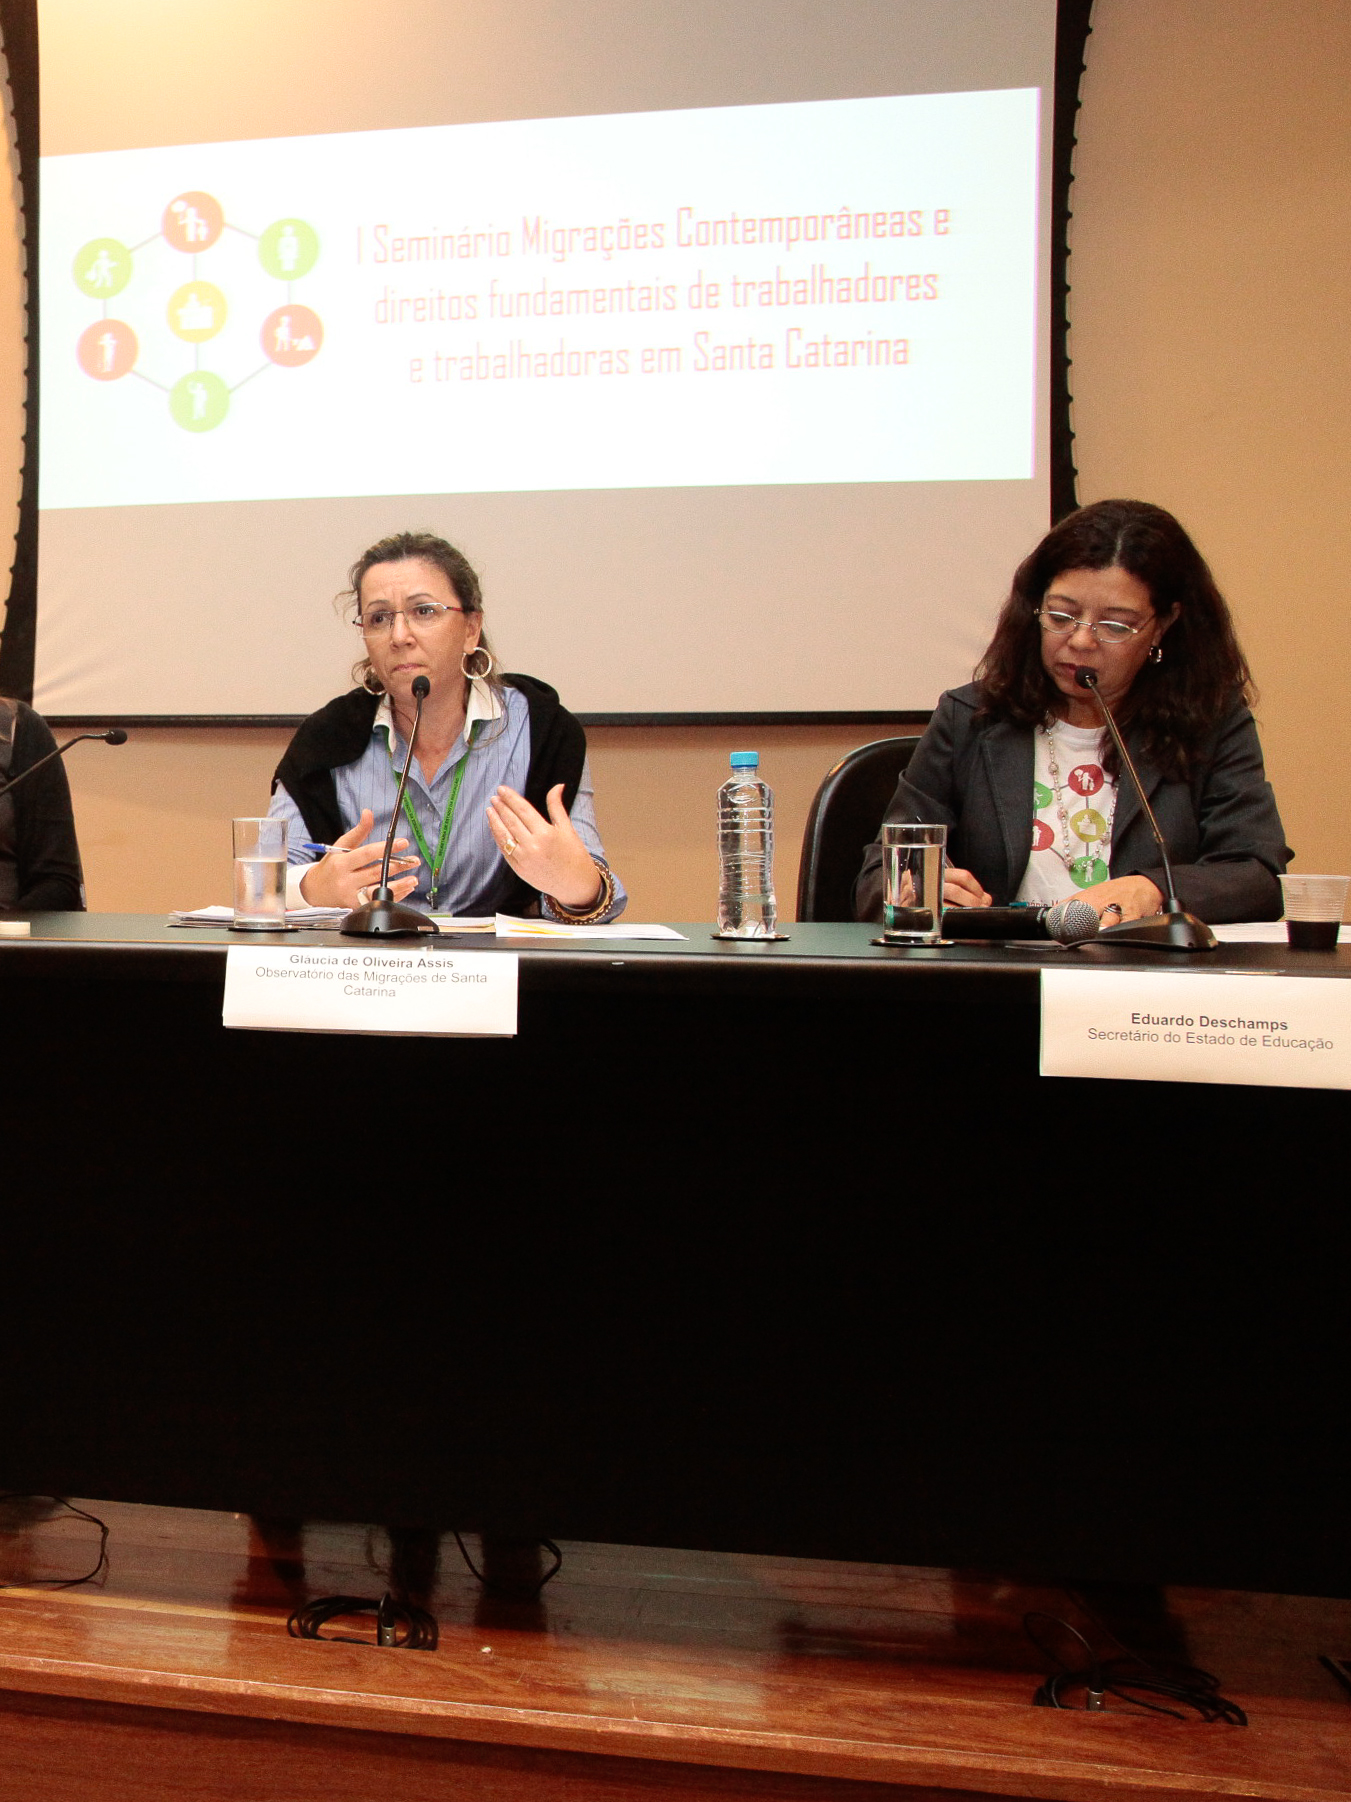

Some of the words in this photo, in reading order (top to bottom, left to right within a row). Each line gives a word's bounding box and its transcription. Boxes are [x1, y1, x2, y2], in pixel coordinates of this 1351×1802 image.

[373, 223, 511, 265] Seminário
[522, 214, 666, 264] Migrações
[676, 205, 924, 252] Contemporâneas
[933, 208, 951, 237] e
[373, 284, 479, 325] direitos
[488, 276, 677, 319] fundamentais
[687, 268, 720, 310] de
[731, 261, 939, 308] trabalhadores
[408, 357, 423, 384] e
[433, 337, 631, 383] trabalhadoras
[641, 347, 682, 375] em
[693, 330, 775, 372] Santa
[785, 326, 911, 369] Catarina
[289, 953, 339, 966] Gláucia
[342, 955, 359, 967] de
[362, 956, 414, 969] Oliveira
[417, 957, 455, 969] Assis
[255, 966, 334, 980] Observatório
[337, 969, 360, 982] das
[363, 970, 428, 986] Migrações
[431, 971, 447, 983] de
[451, 972, 488, 984] Santa
[343, 984, 397, 998] Catarina
[1131, 1012, 1195, 1028] Eduardo
[1199, 1015, 1289, 1033] Deschamps
[1087, 1027, 1159, 1043] Secretário
[1163, 1030, 1181, 1044] do
[1186, 1031, 1235, 1046] Estado
[1239, 1033, 1257, 1047] de
[1262, 1034, 1334, 1052] Educação
